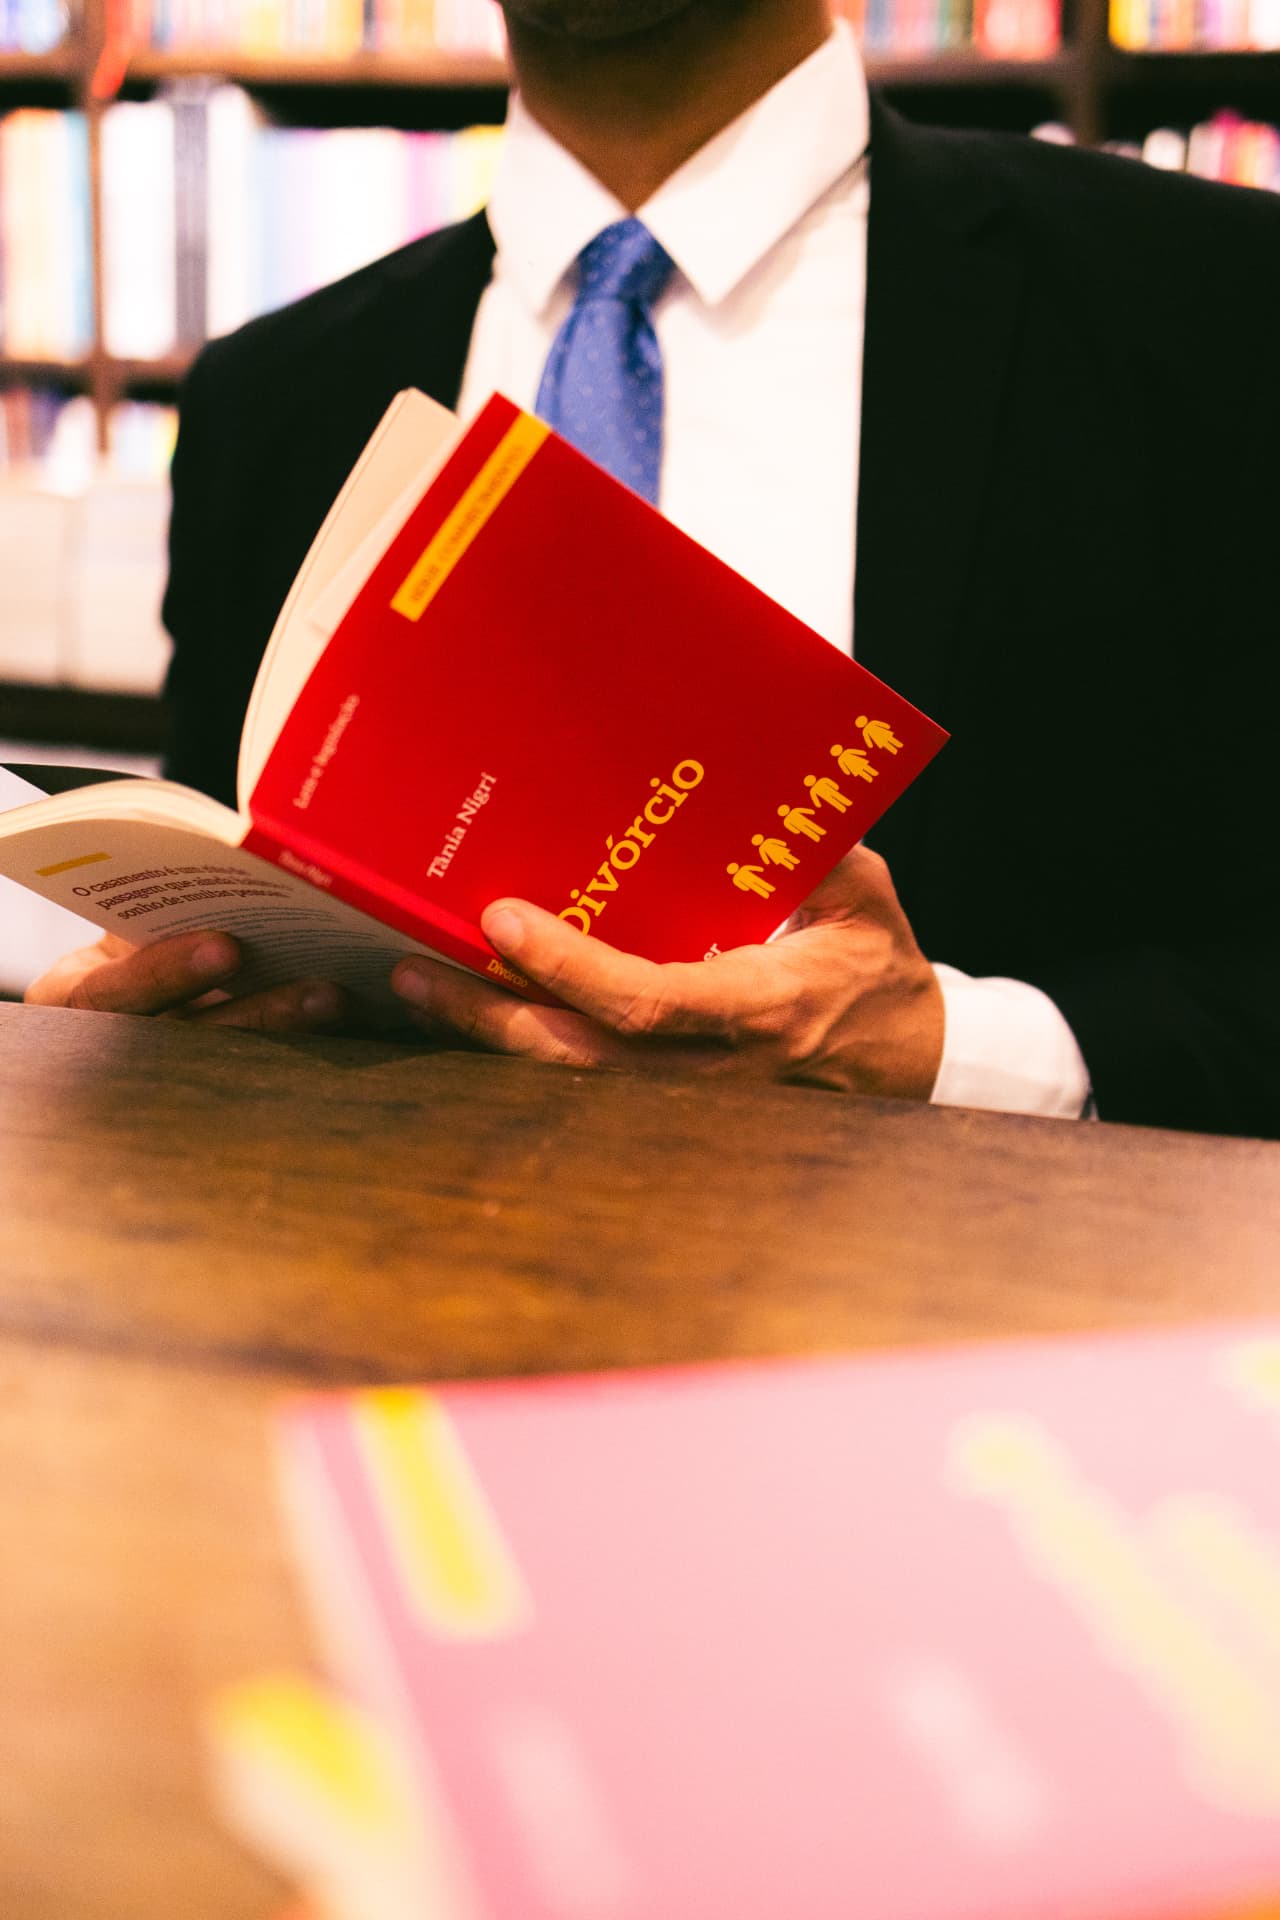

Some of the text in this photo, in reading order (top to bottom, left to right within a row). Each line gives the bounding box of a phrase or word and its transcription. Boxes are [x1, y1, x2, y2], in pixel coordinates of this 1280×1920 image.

[426, 771, 498, 879] Tânia Nigri
[556, 758, 705, 936] Divórcio
[72, 886, 92, 898] O
[89, 869, 168, 893] casamento
[94, 884, 168, 911] passagem
[164, 879, 196, 892] que
[117, 901, 165, 920] sonho
[160, 895, 185, 907] de
[180, 889, 236, 902] muitas
